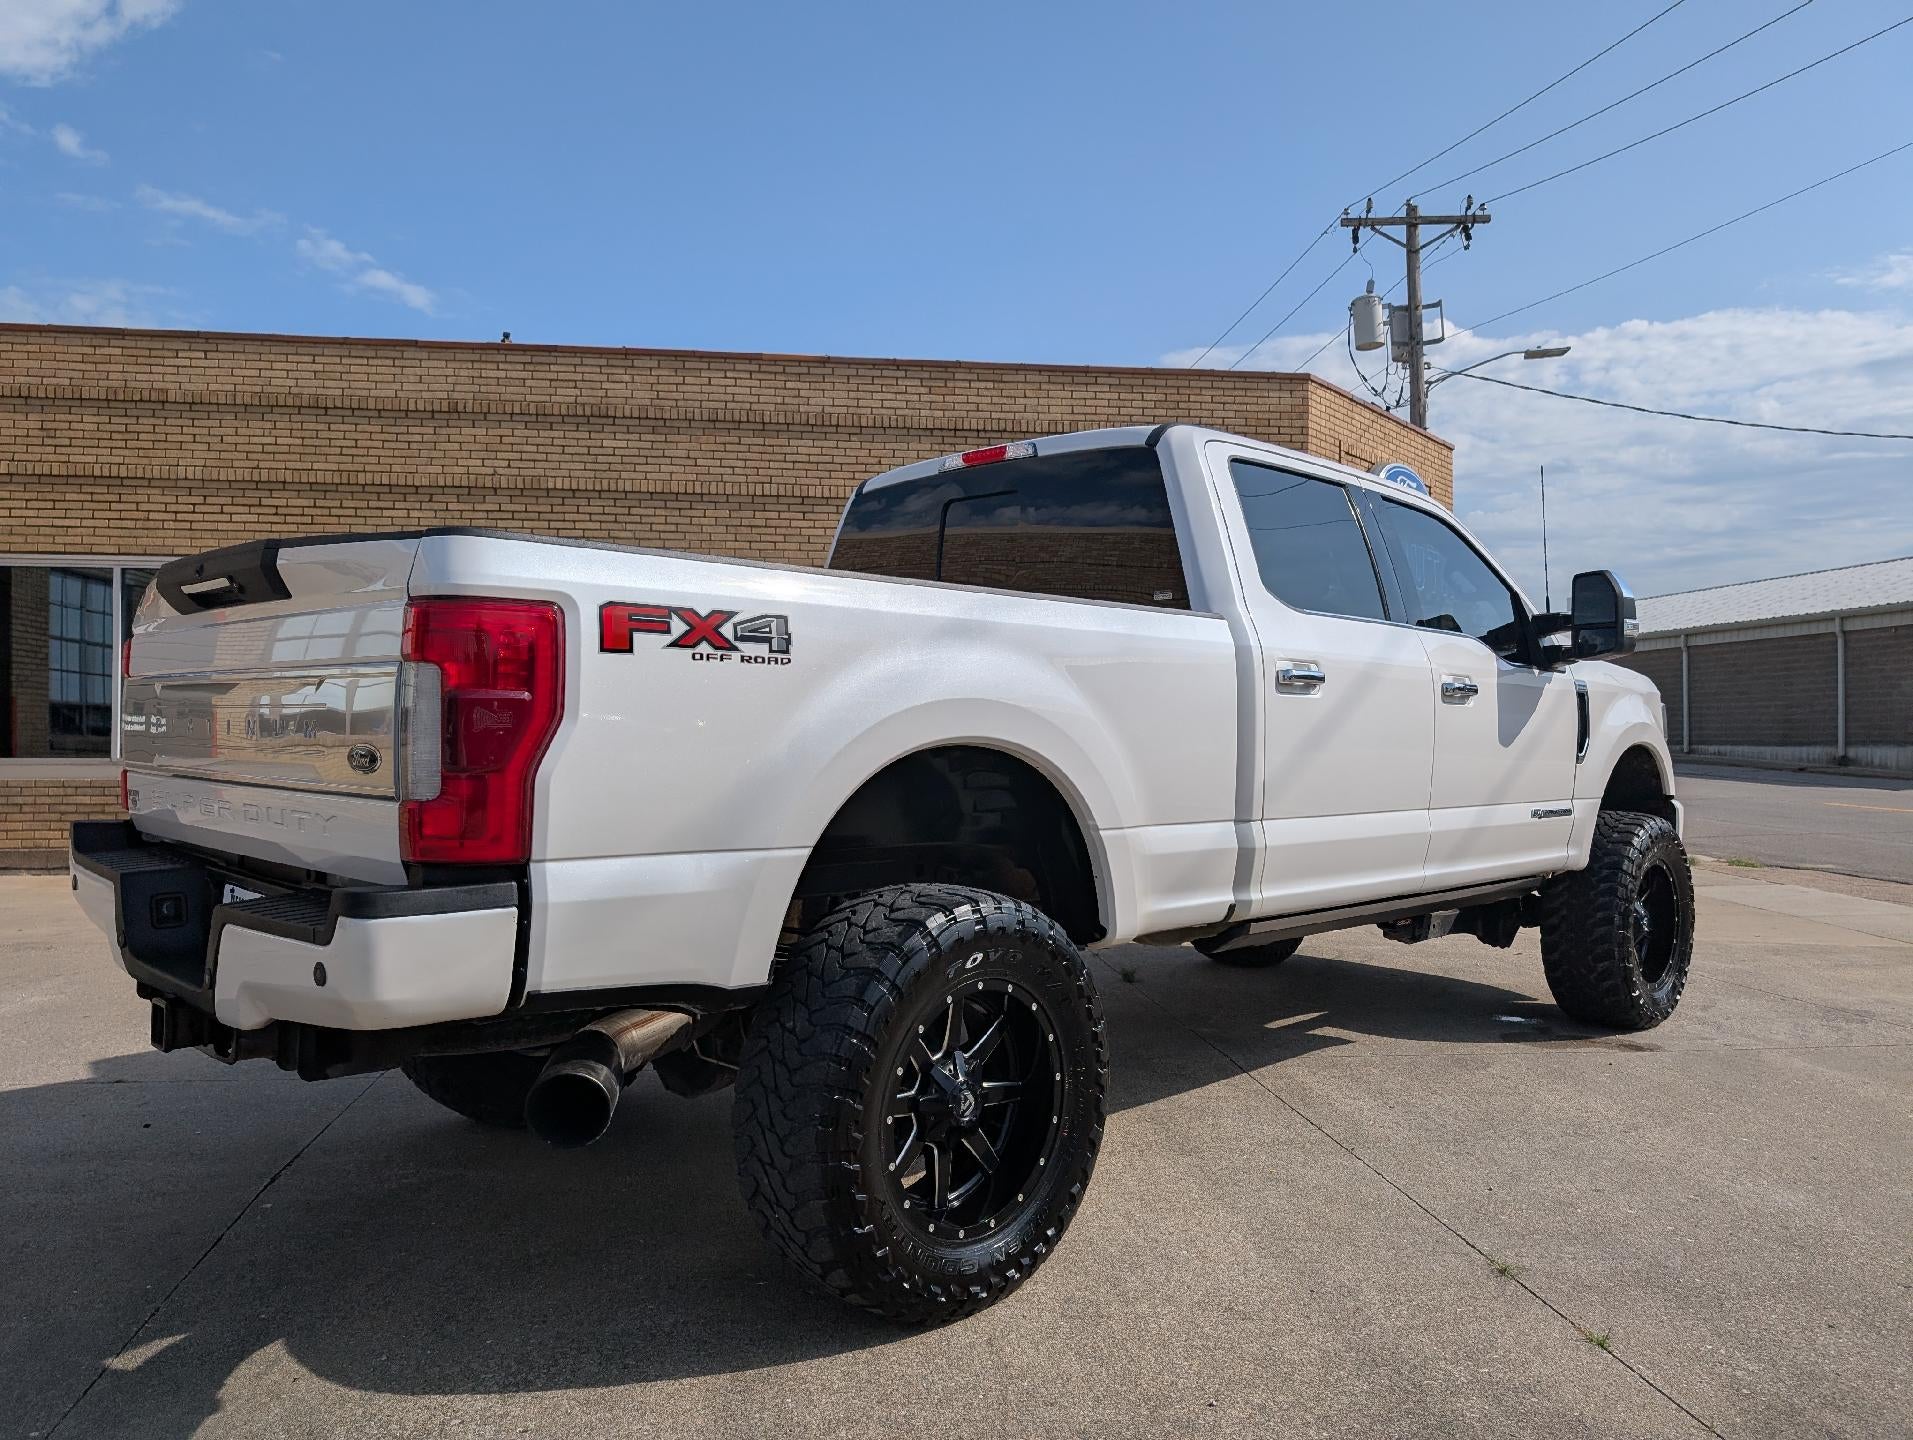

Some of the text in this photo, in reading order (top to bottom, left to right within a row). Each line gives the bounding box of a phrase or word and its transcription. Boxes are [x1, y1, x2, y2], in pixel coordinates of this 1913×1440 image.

[598, 600, 792, 655] FX4
[692, 652, 791, 665] OFF ROAD
[152, 790, 234, 820] SUPER
[243, 803, 337, 836] DUTY
